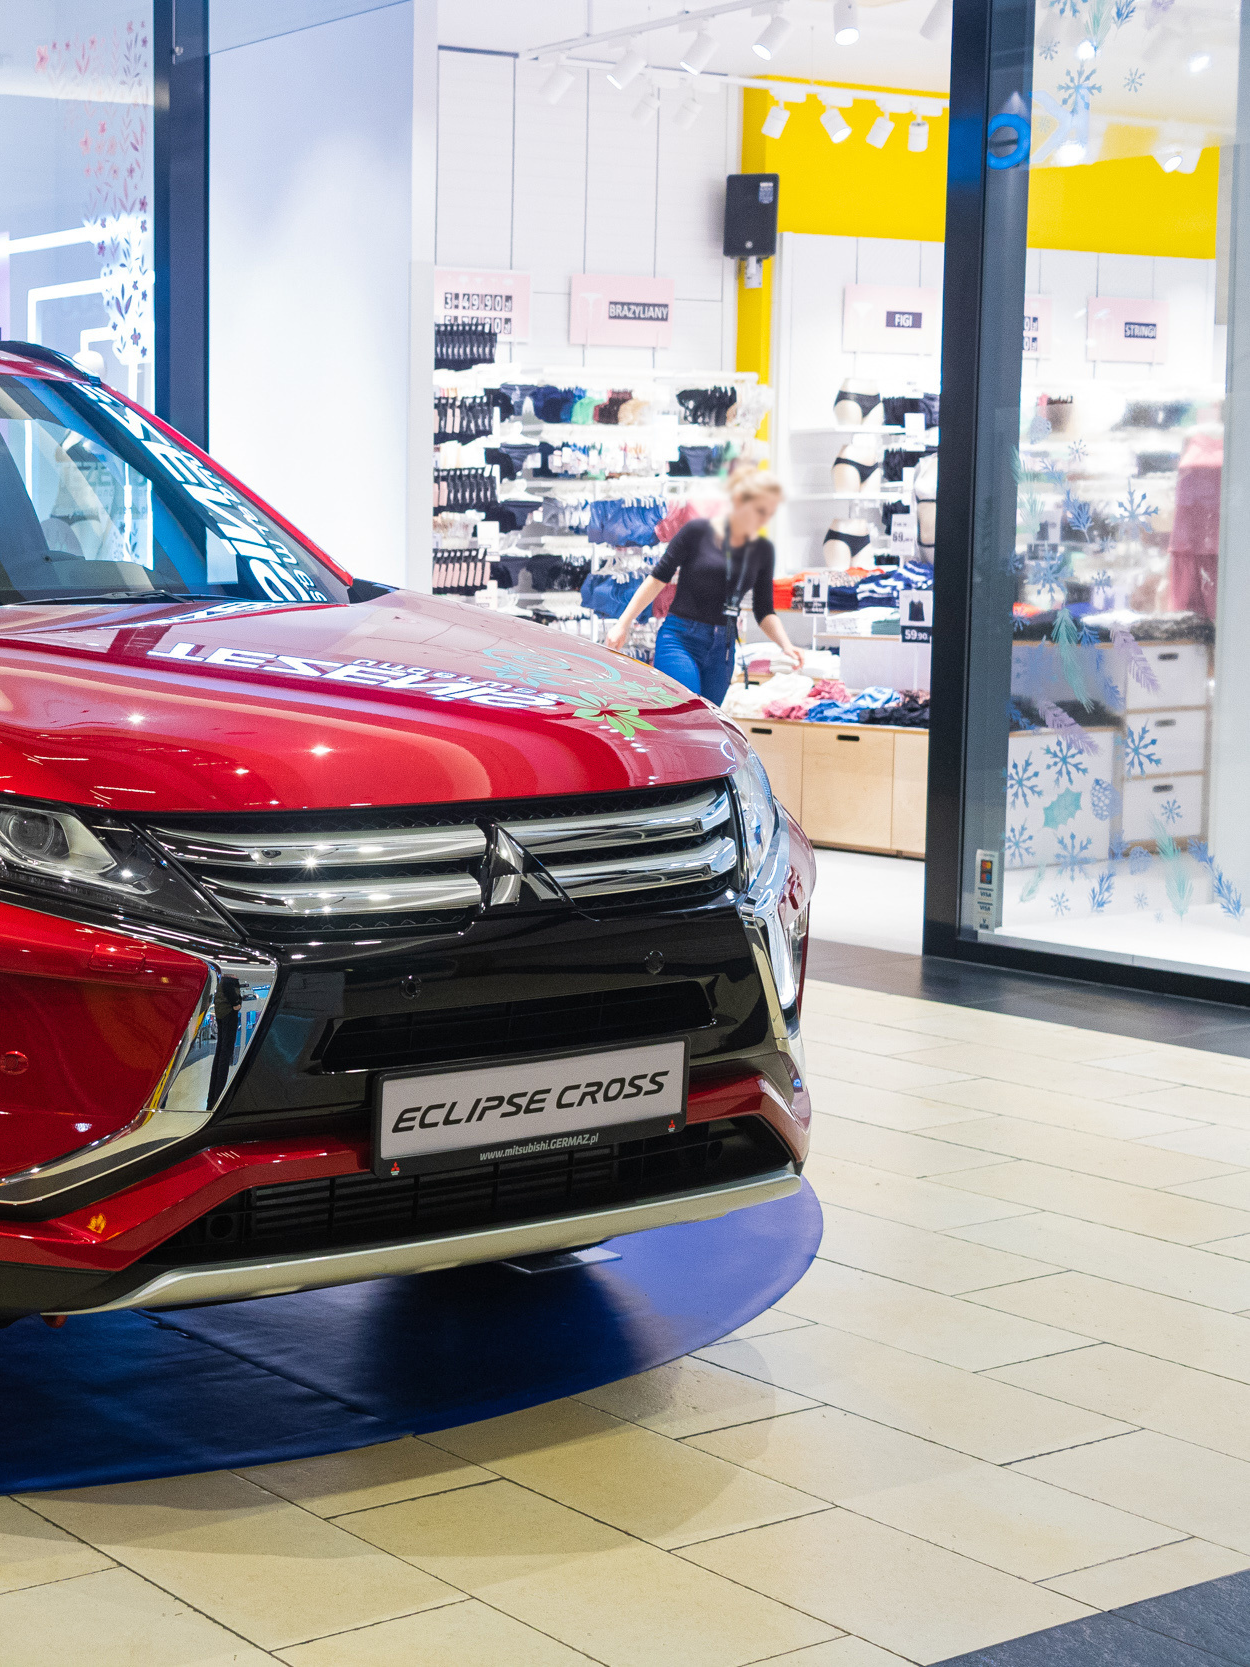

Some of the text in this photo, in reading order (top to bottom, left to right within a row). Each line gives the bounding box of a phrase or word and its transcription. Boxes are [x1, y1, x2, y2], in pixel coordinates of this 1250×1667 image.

[609, 303, 668, 319] BRAZYLIANY
[895, 313, 913, 327] FIGI
[391, 1070, 670, 1134] ECLIPSE CROSS
[479, 1133, 599, 1161] www.mitsubishi.GERMAZ.pl
